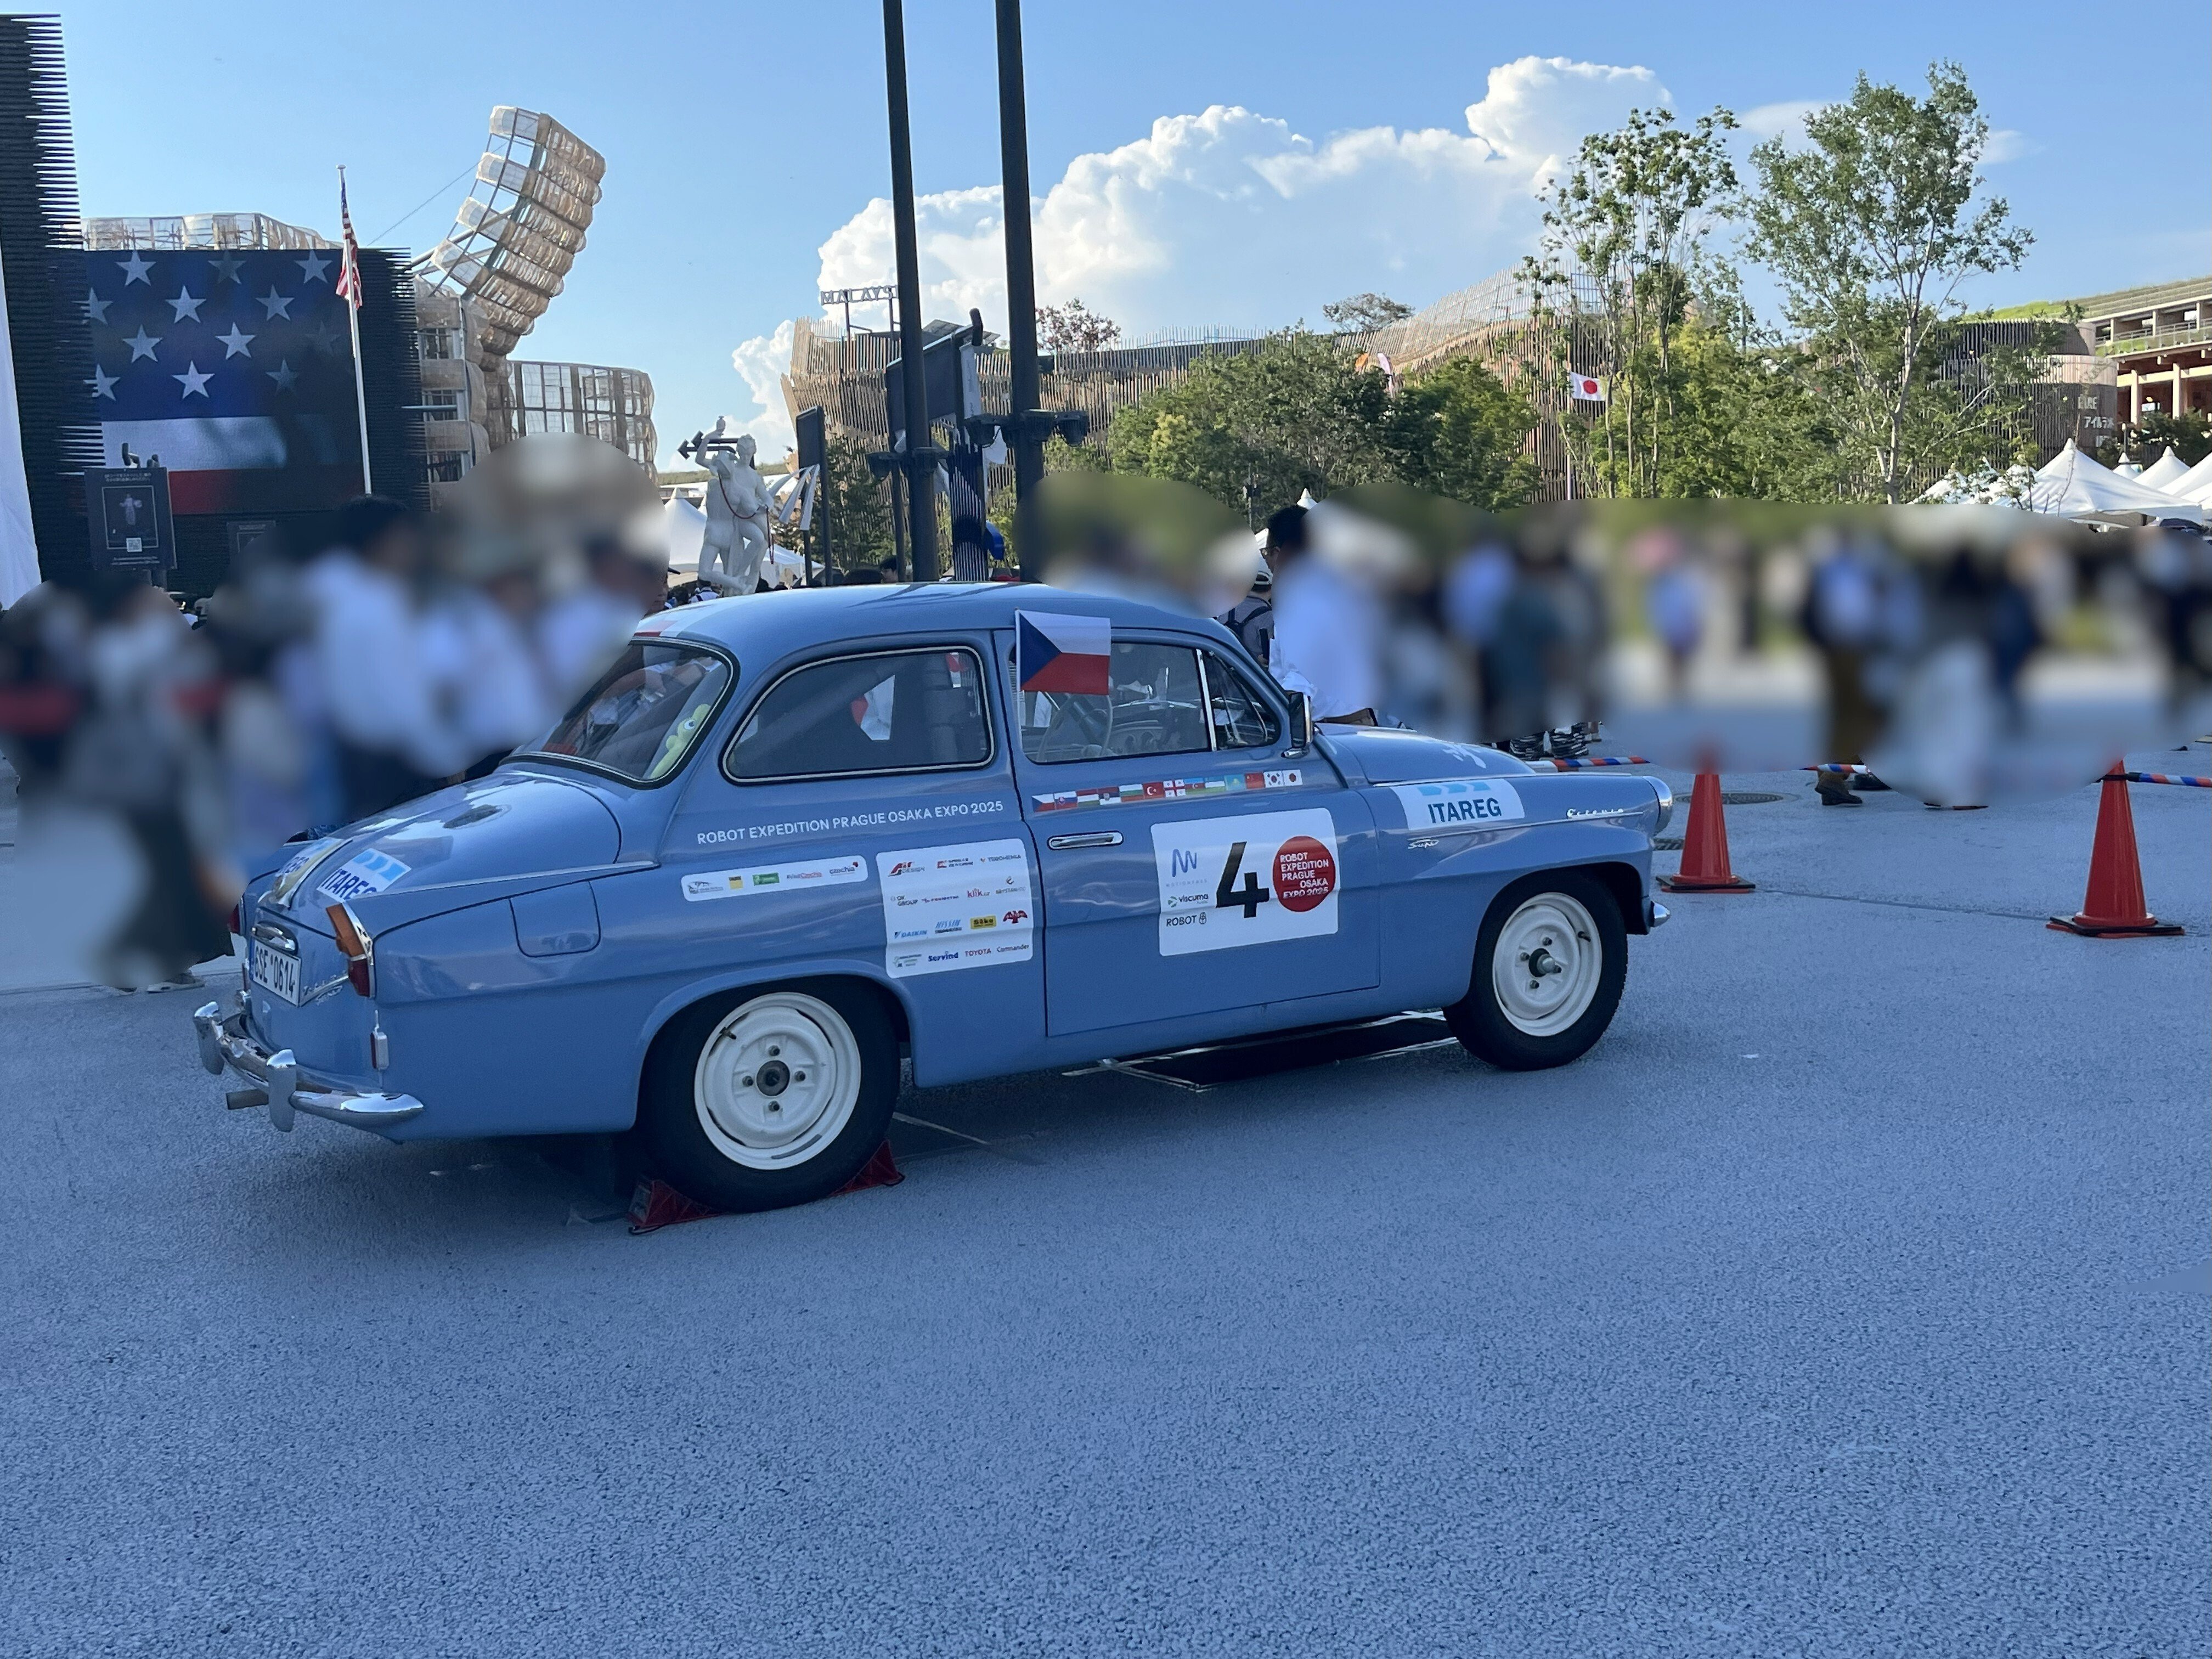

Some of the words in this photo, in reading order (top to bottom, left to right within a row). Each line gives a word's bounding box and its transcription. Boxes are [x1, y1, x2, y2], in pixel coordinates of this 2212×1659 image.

[821, 285, 899, 306] MALAYSI
[1427, 797, 1502, 823] ITAREG
[697, 828, 745, 844] ROBOT
[749, 819, 830, 839] EXPEDITION
[832, 812, 886, 829] PRAGUE
[888, 808, 932, 822] OSAKA
[934, 804, 969, 817] EXPO
[970, 800, 1003, 814] 2025
[1280, 852, 1308, 863] ROBOT
[1280, 859, 1329, 872] EXPEDITION
[1215, 841, 1270, 918] 4
[1282, 870, 1316, 881] PRAGUE
[1300, 878, 1329, 888] OSAKA
[1283, 890, 1305, 899] EXPO
[1307, 887, 1329, 896] 2025
[1166, 915, 1197, 927] ROBOT
[964, 947, 992, 957] TOYOTA
[274, 955, 296, 998] 0614
